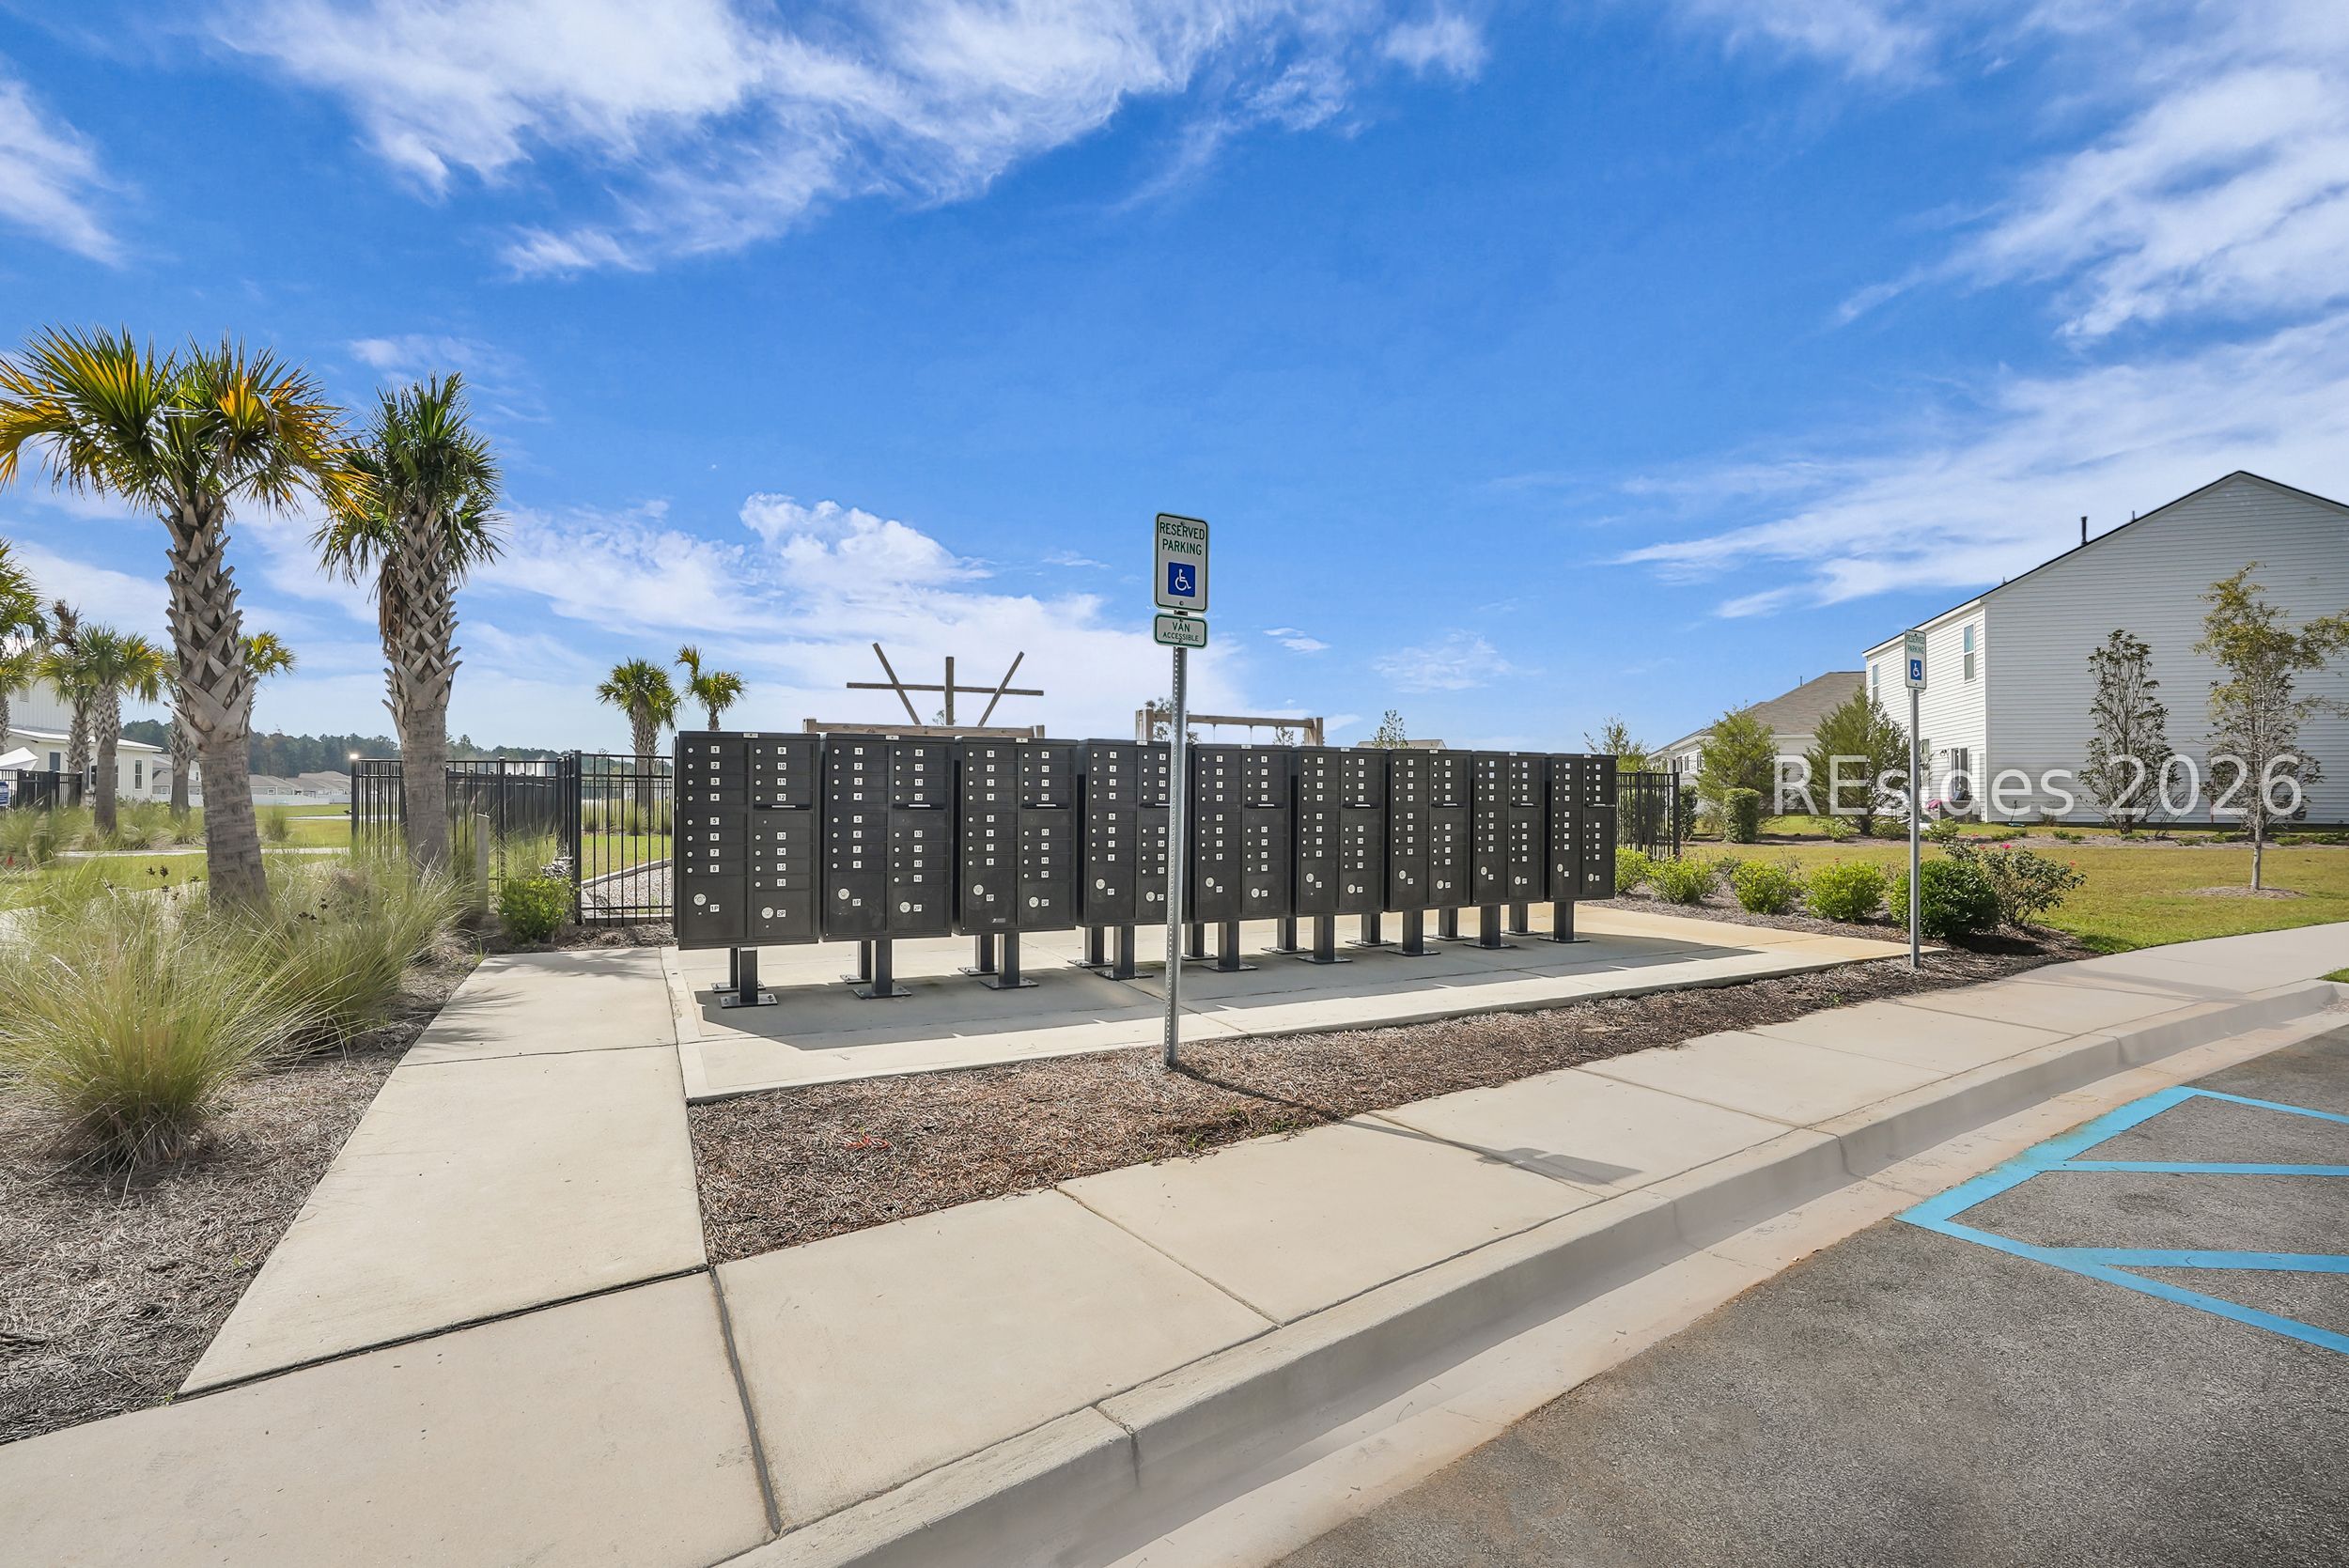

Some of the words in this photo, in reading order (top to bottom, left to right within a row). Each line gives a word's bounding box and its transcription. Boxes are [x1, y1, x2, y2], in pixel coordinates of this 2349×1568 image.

[1159, 521, 1205, 540] RESERVED
[1162, 538, 1202, 556] PARKING
[1172, 621, 1190, 632] VAN
[1162, 631, 1199, 642] ACCESSIBLE
[1907, 644, 1924, 655] PARKING
